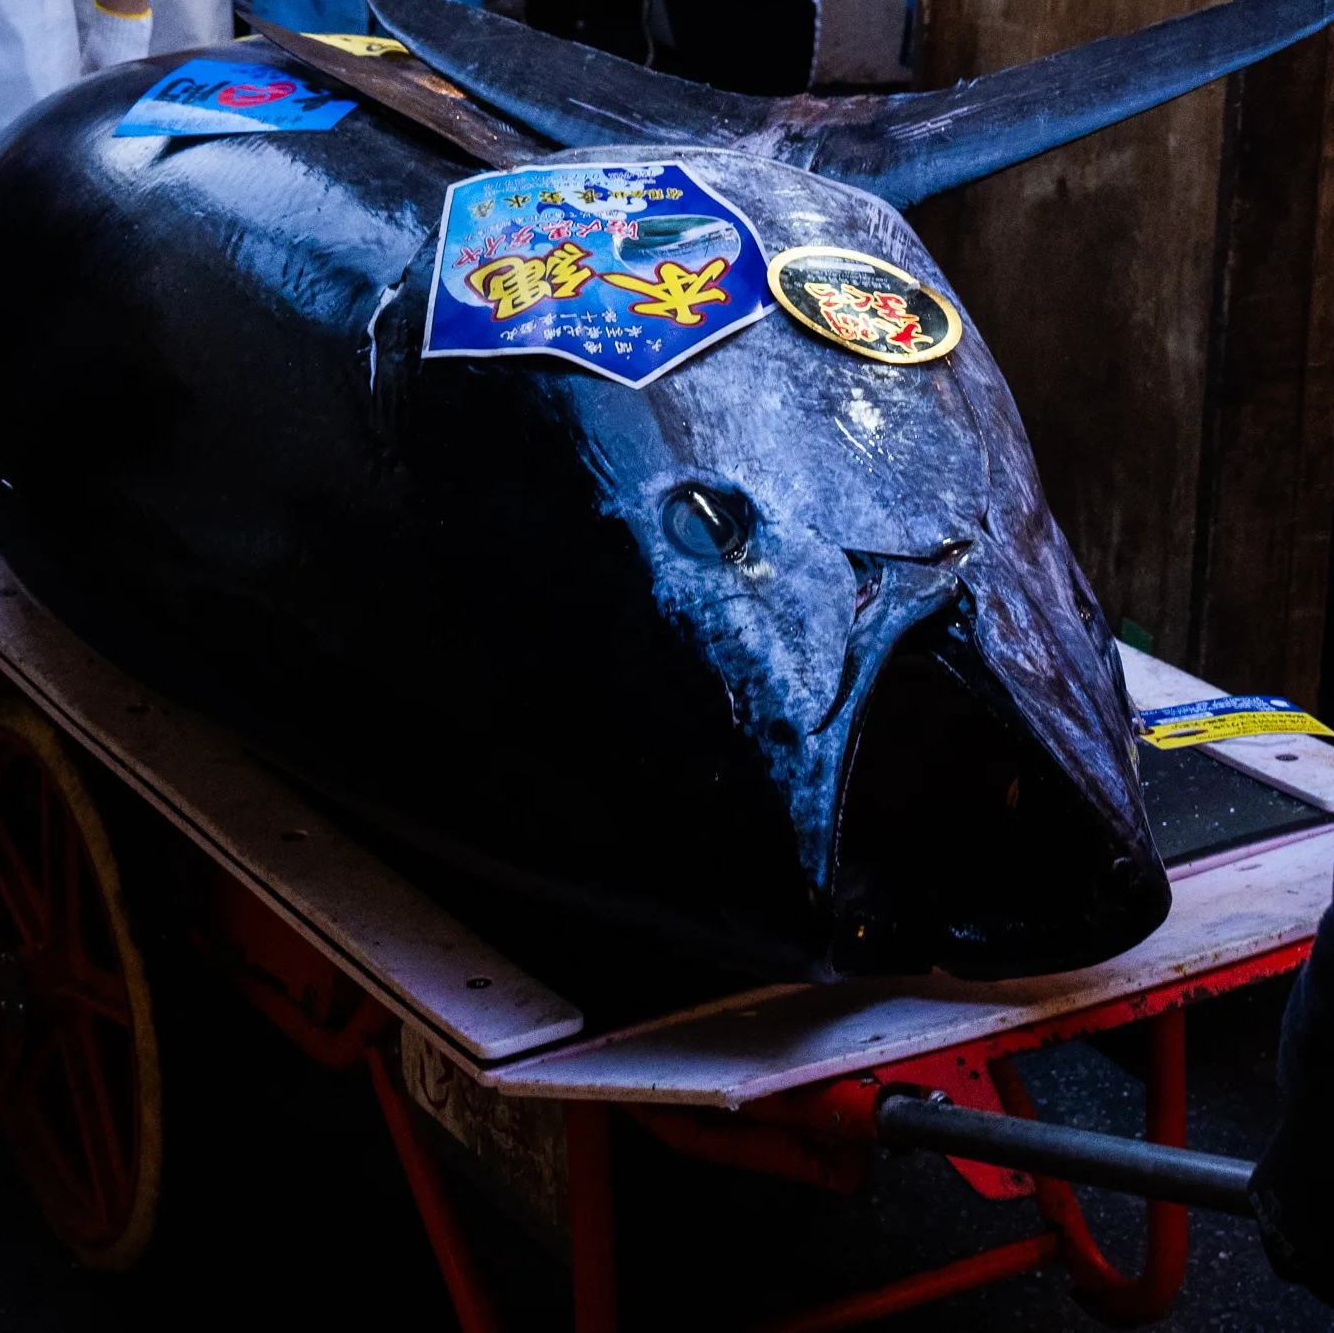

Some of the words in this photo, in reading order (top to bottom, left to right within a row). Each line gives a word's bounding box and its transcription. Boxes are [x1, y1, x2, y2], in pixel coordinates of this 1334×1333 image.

[543, 324, 643, 341] 本州最北端
